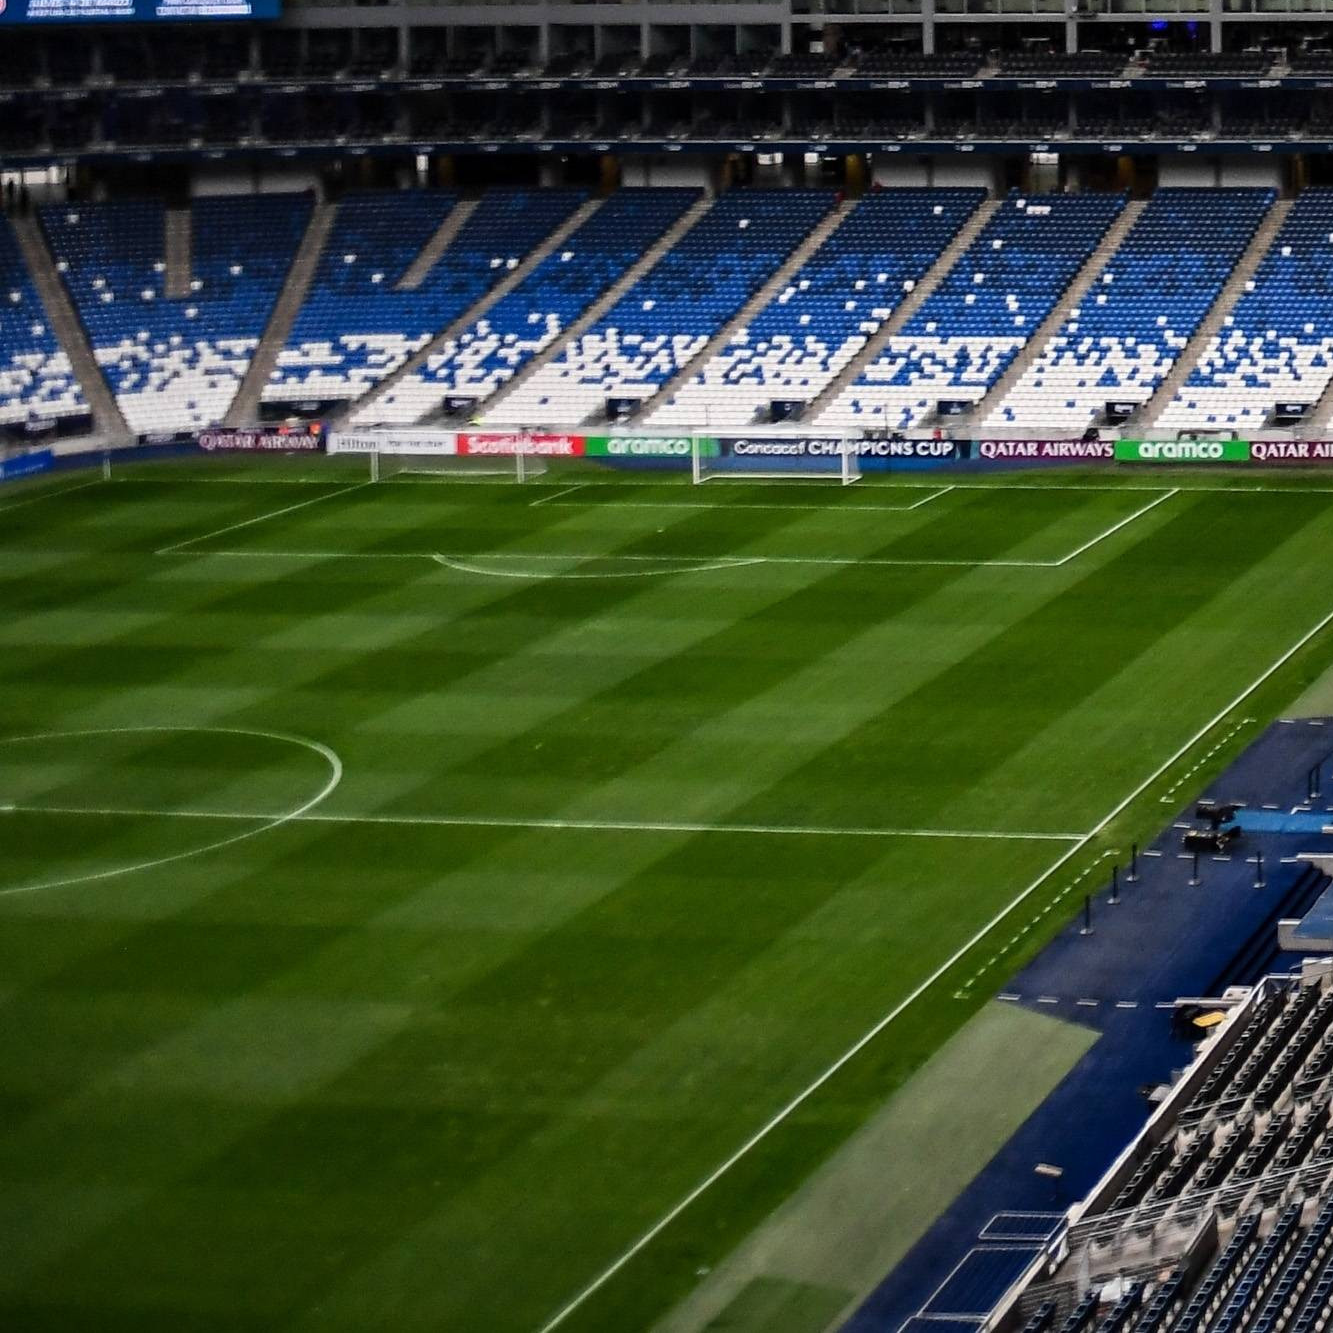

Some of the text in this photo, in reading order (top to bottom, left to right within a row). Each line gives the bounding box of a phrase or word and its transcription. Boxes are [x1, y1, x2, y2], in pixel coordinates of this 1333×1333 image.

[468, 435, 573, 454] Scotiabank
[607, 438, 691, 454] aramco
[734, 440, 954, 456] Concacaf CHAMPIONS CUP
[980, 442, 1114, 459] QATAR AIRWAYS
[1138, 442, 1224, 459] aramco
[1251, 443, 1309, 459] QATAR
